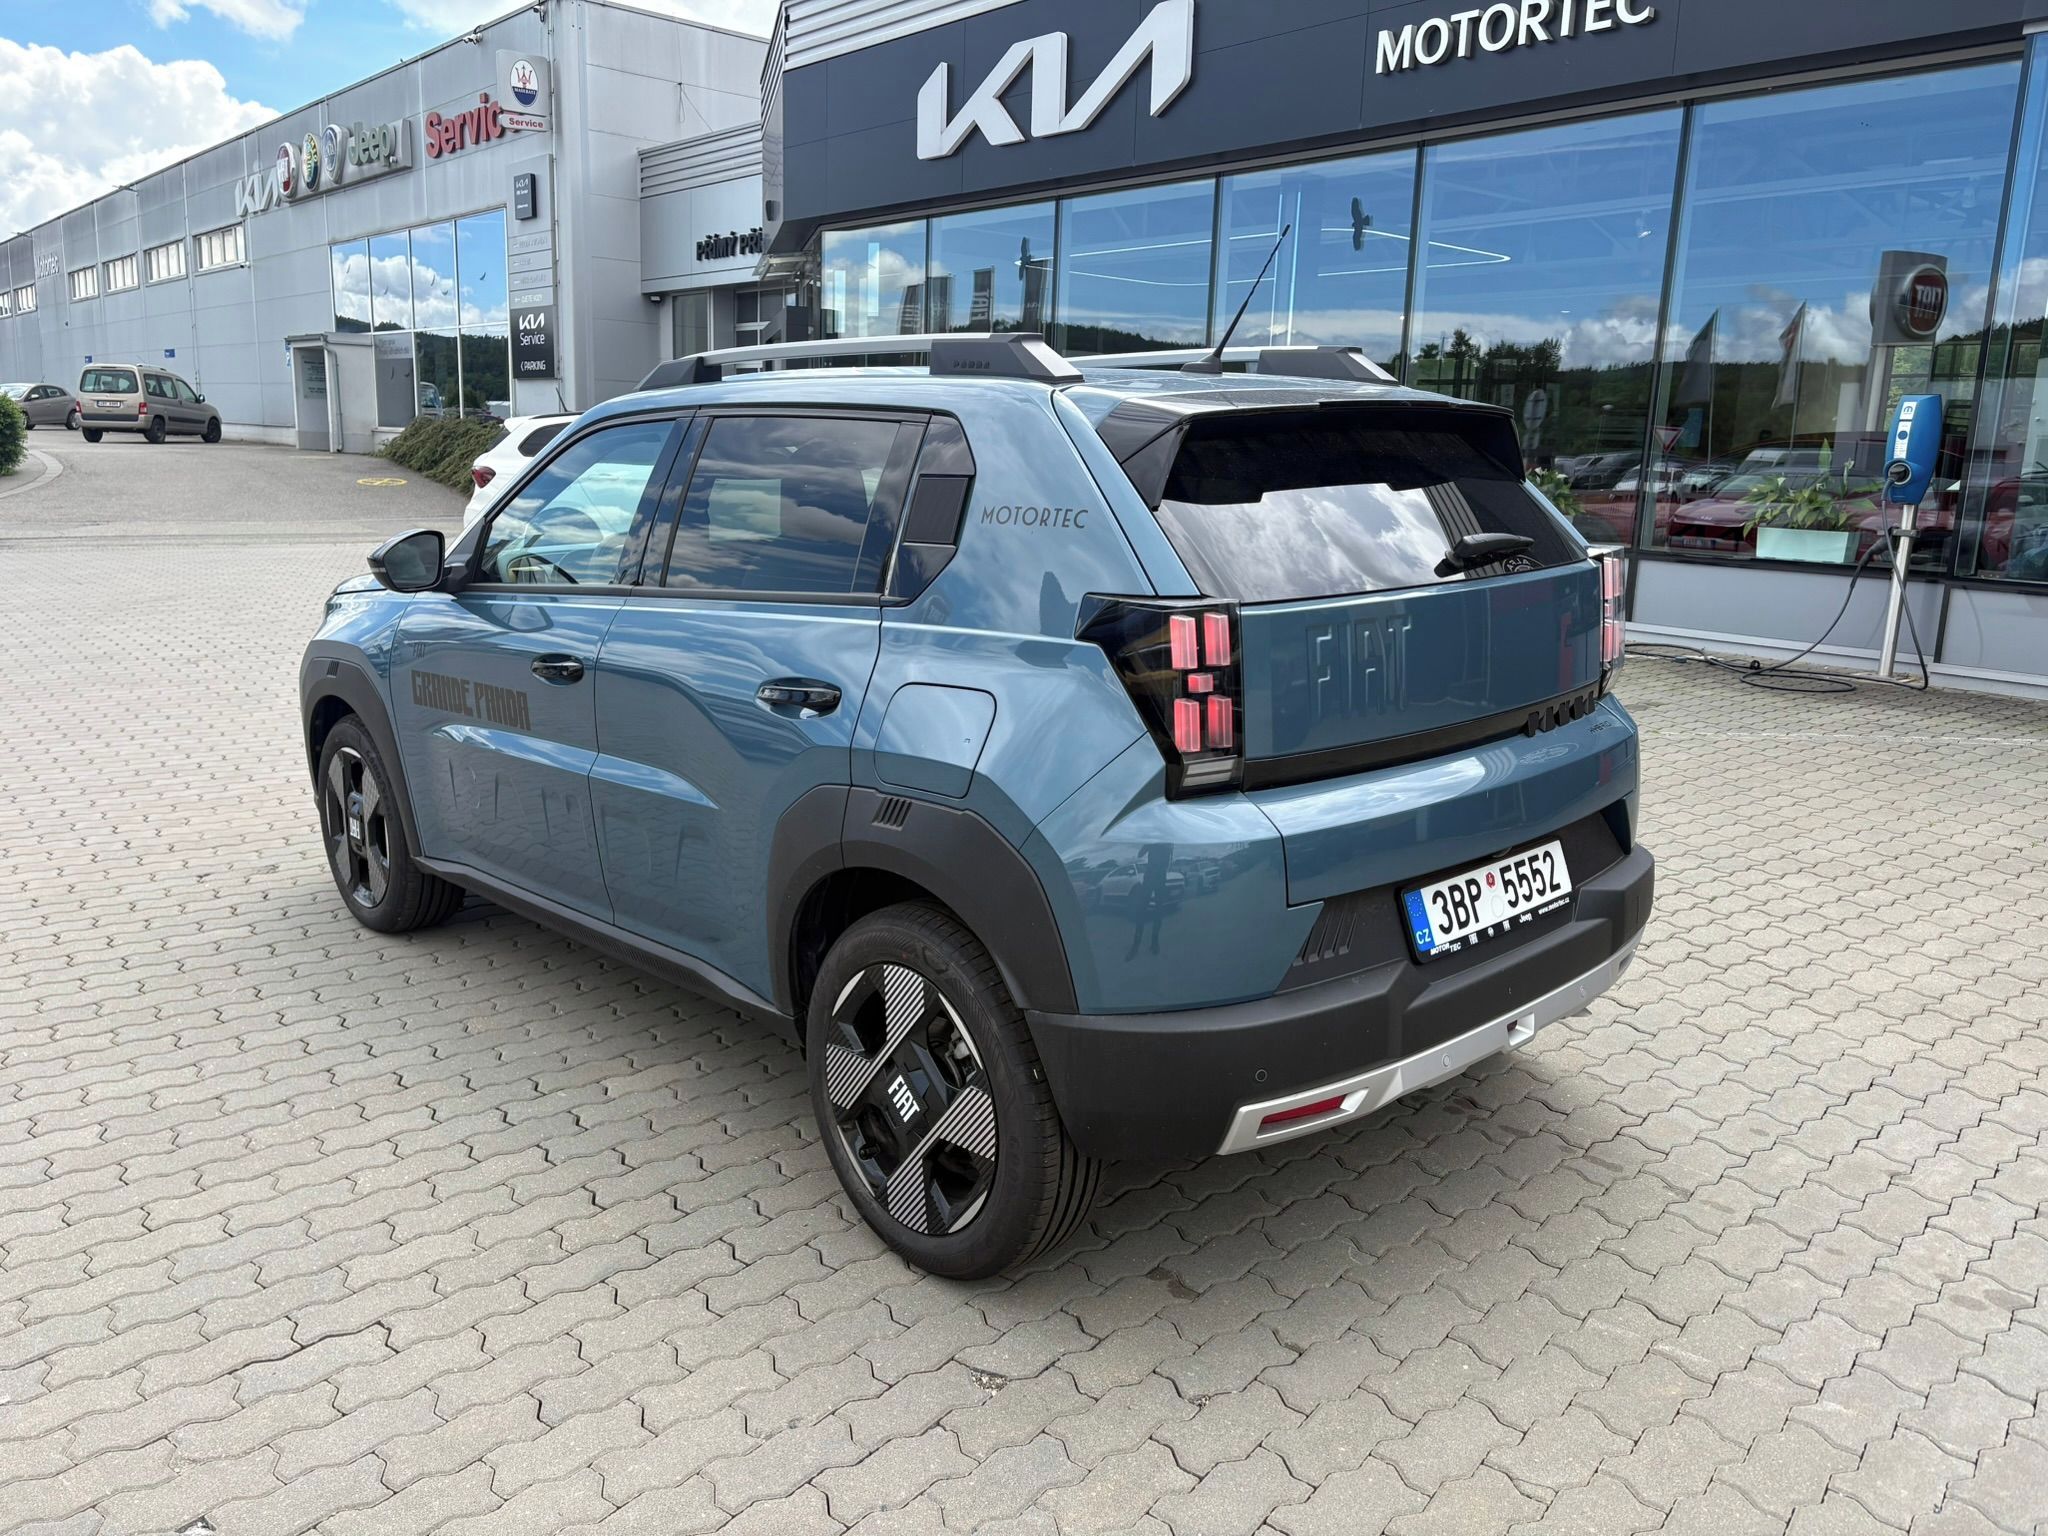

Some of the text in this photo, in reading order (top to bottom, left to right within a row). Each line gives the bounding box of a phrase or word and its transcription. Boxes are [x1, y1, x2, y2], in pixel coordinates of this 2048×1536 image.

[1375, 0, 1655, 75] MOTORTEC
[917, 0, 1195, 161] KIA
[349, 121, 391, 168] Jeep
[425, 92, 520, 159] Servic
[509, 117, 544, 129] Service
[234, 167, 281, 217] KIA
[519, 312, 545, 330] KIA
[520, 331, 545, 346] Service
[524, 359, 546, 371] PARKING
[981, 506, 1088, 529] MOTORTEC
[1306, 613, 1412, 722] FIAT
[411, 670, 532, 731] GRANDE PANDA
[1432, 850, 1562, 935] 3BP 5552
[1415, 929, 1432, 945] CZ
[1519, 912, 1533, 924] Jeep
[887, 1074, 921, 1123] FIAT
